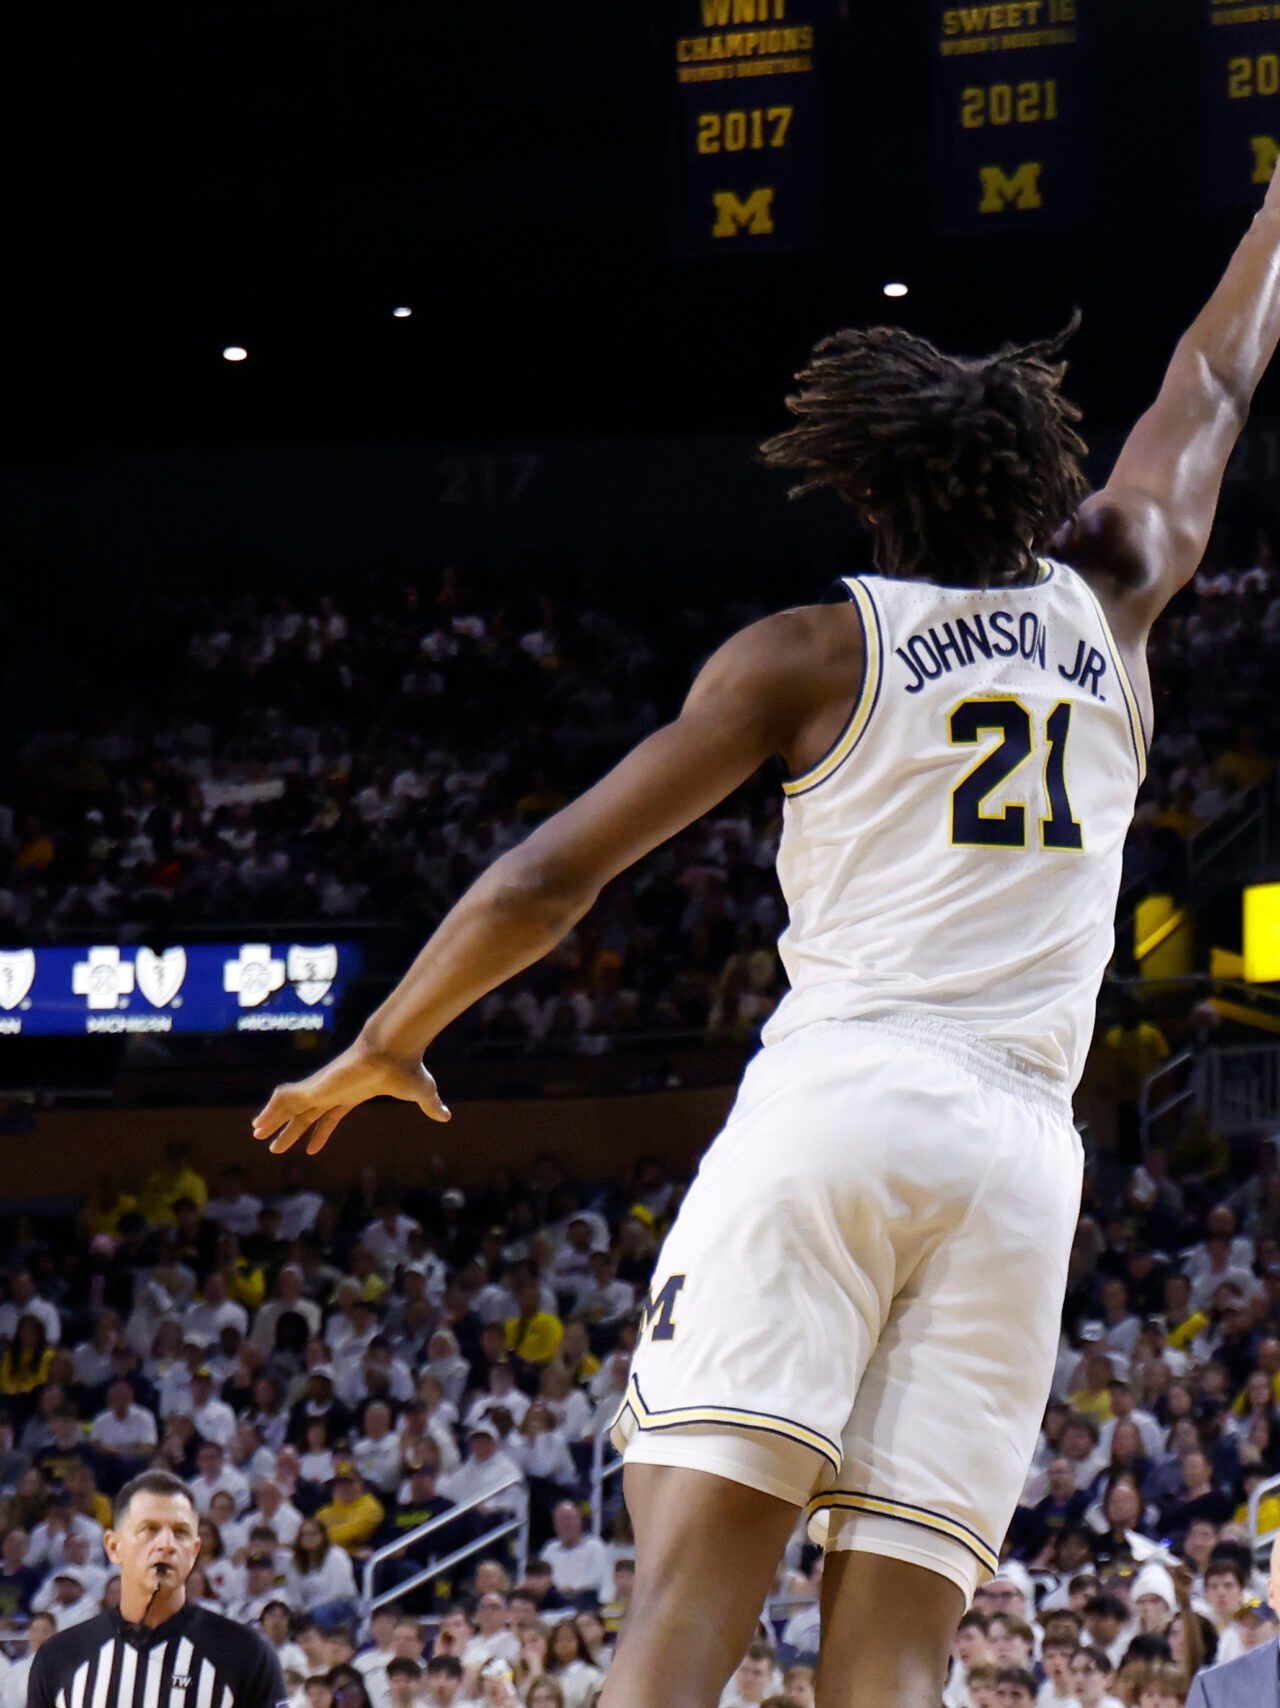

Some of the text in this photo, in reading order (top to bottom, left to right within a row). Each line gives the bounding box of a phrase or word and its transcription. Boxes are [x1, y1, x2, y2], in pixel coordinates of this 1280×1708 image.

[676, 25, 814, 62] CHAMPIONS
[943, 1, 1041, 35] SWEET
[696, 104, 795, 156] 2017
[960, 79, 1057, 129] 2021
[711, 186, 777, 238] M
[979, 163, 1042, 213] M
[895, 611, 1107, 702] JOHNSON JR.
[945, 694, 1085, 853] 21
[641, 1272, 689, 1343] M
